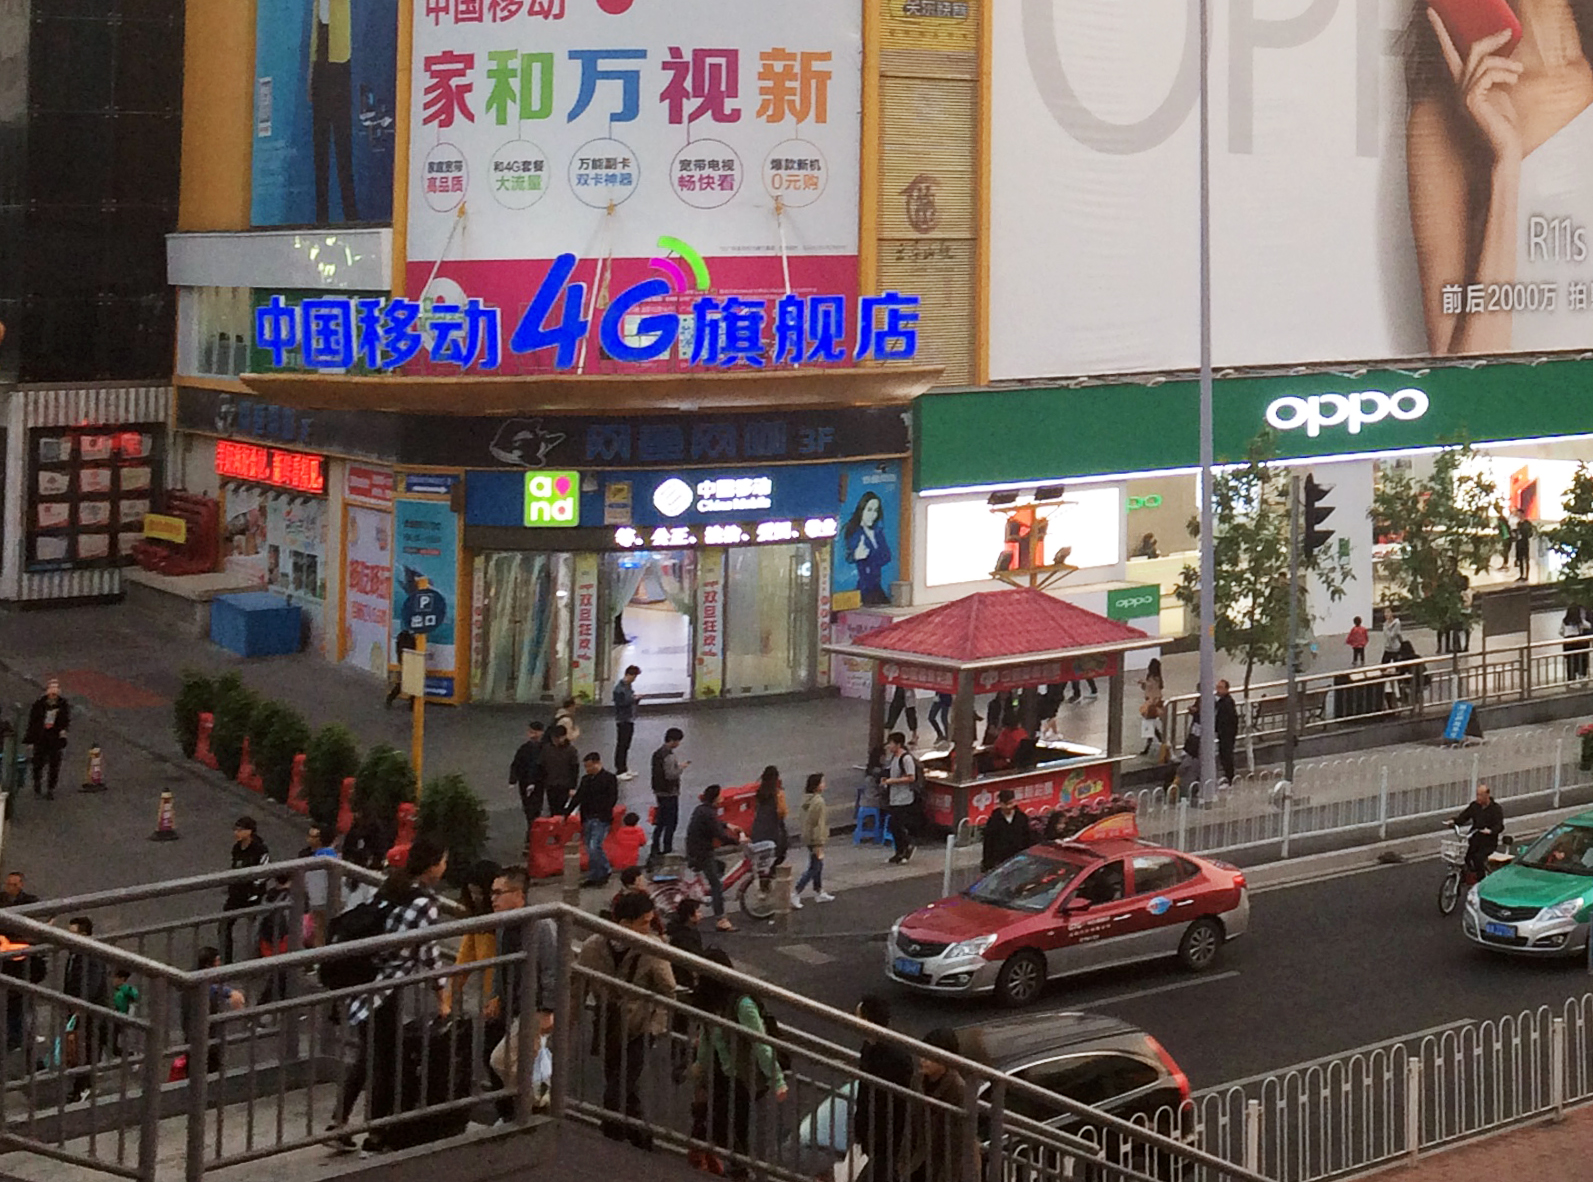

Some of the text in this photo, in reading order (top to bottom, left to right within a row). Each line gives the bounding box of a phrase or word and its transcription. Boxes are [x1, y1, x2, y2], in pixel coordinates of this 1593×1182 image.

[422, 47, 832, 128] 家和万视新
[494, 160, 544, 174] 和4G套餐
[578, 158, 631, 172] 万能副卡
[679, 159, 734, 173] 宽带电视
[770, 158, 821, 173] 爆款新机
[426, 176, 463, 193] 高品质
[495, 175, 543, 192] 大流量
[677, 174, 734, 192] 畅快看
[1528, 215, 1588, 262] R11s
[1442, 282, 1557, 314] 前后2000万
[255, 253, 921, 369] 中国移动4G旗舰店
[798, 426, 835, 453] 3F
[420, 596, 430, 608] P
[411, 615, 437, 627] 出口
